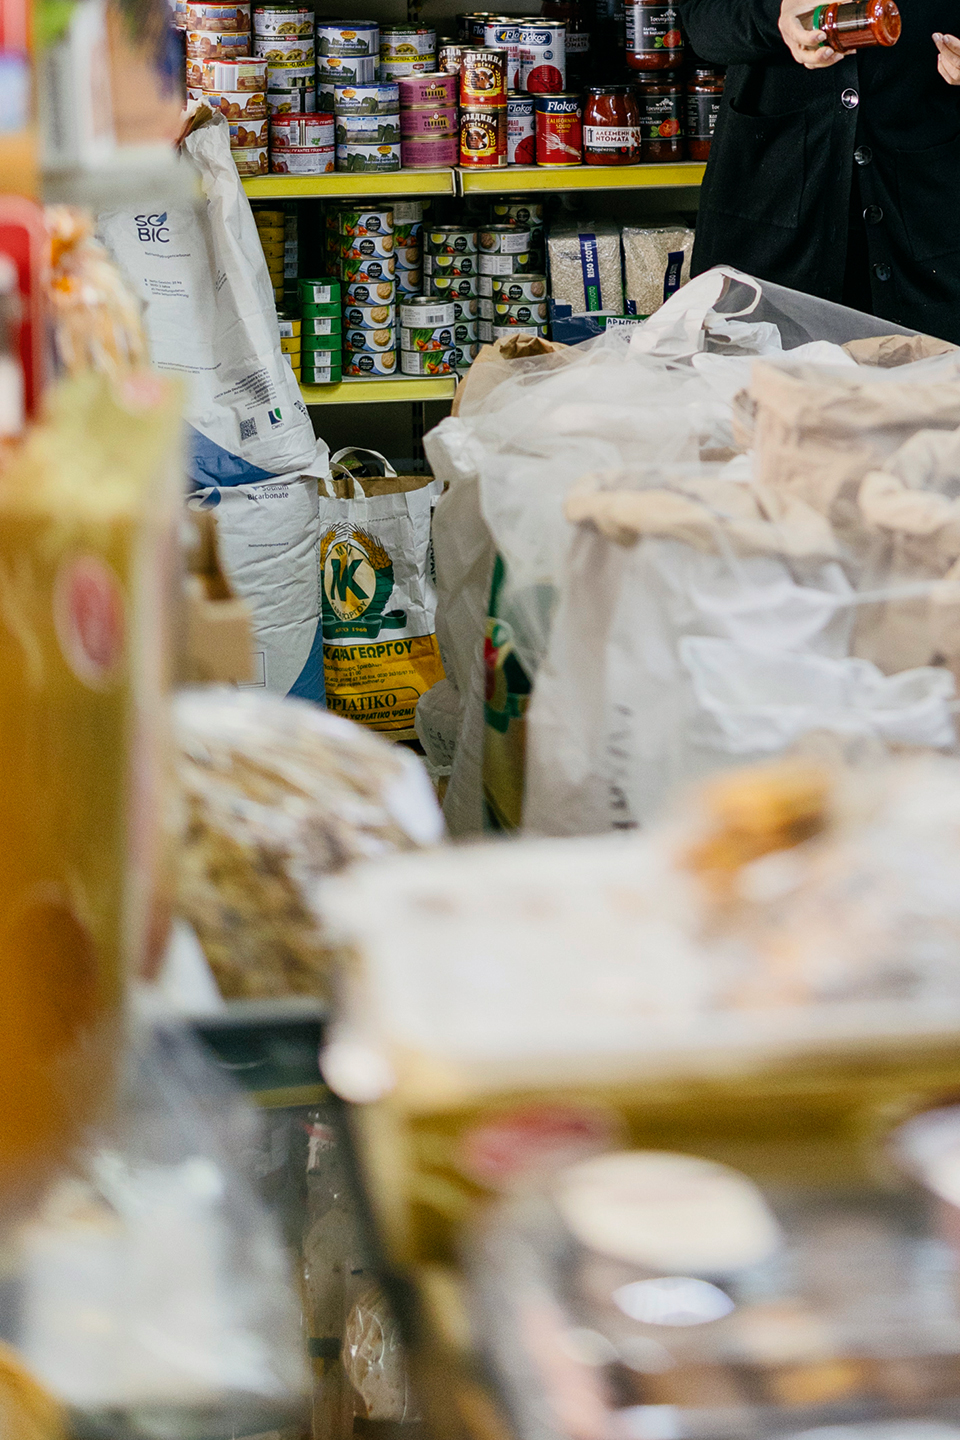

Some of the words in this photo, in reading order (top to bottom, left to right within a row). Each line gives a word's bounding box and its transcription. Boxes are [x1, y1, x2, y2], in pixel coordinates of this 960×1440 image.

[506, 30, 520, 40] Flo
[521, 32, 548, 44] Flokos
[508, 103, 532, 115] Flokos
[547, 101, 578, 112] Flokos
[461, 113, 497, 126] ГОВЯДИНА
[138, 227, 170, 243] BIC
[586, 263, 596, 278] RISO
[247, 492, 289, 501] Bicarbonate
[351, 710, 390, 720] ΧΩΡΙΑΤΙΚΟ
[392, 707, 414, 716] ΨΩΜΙ
